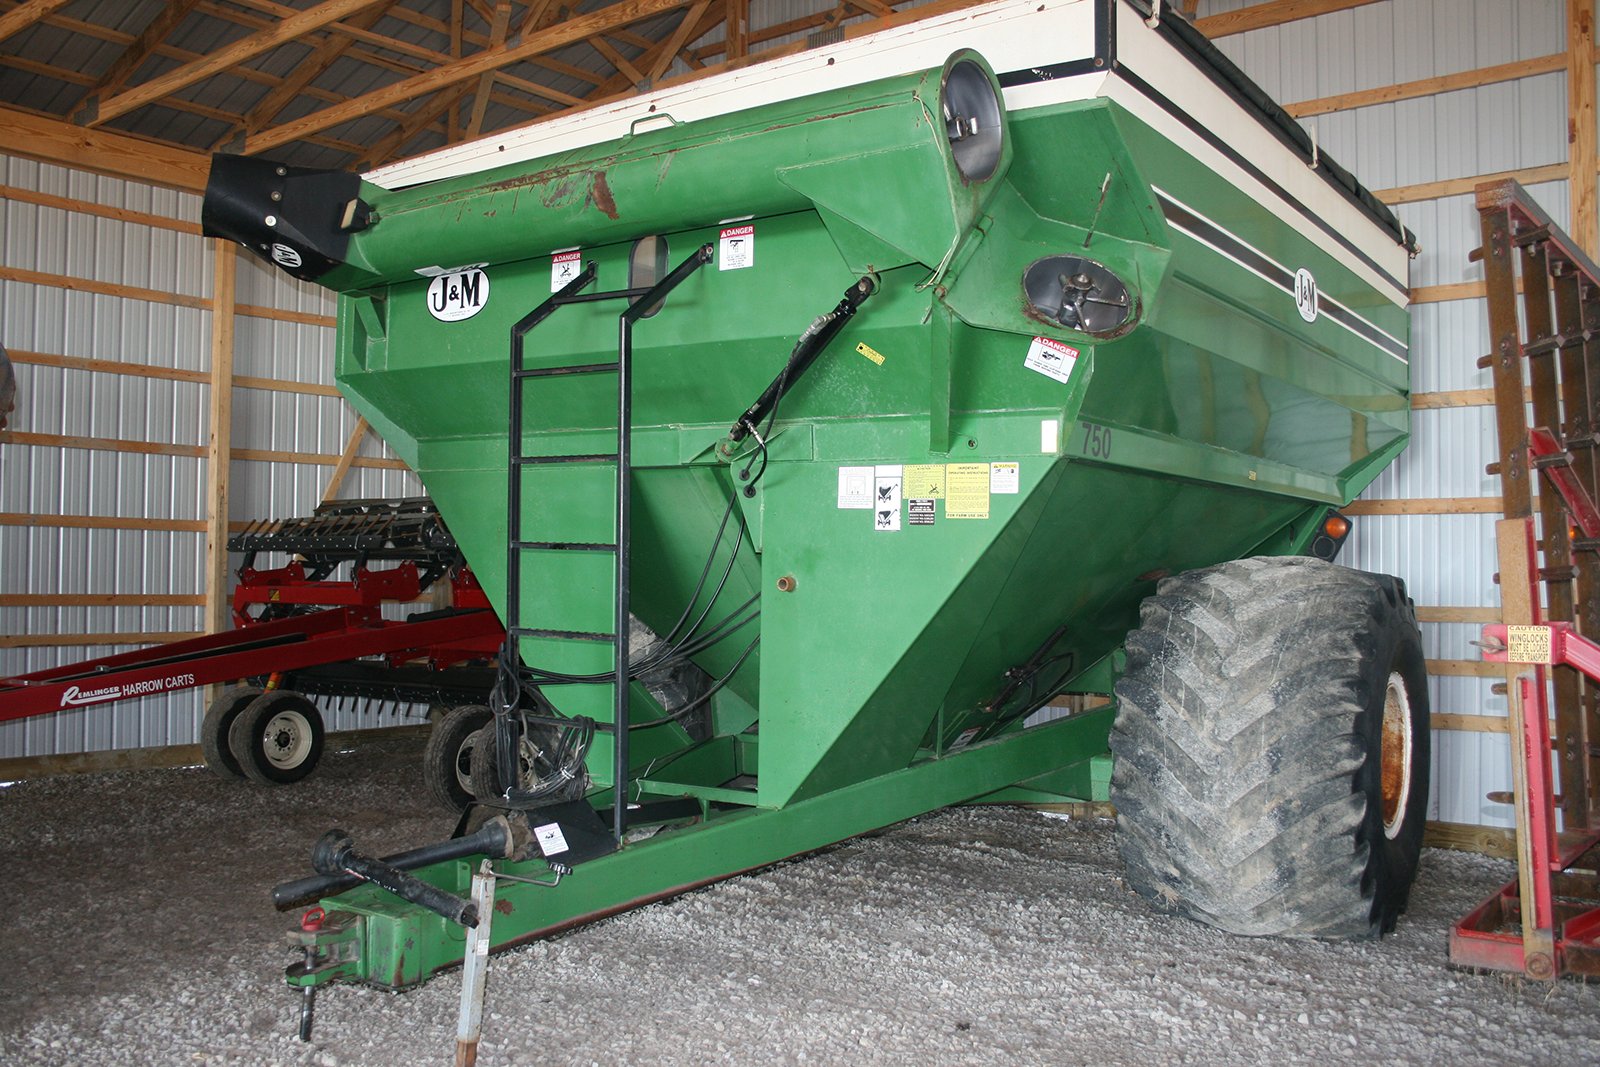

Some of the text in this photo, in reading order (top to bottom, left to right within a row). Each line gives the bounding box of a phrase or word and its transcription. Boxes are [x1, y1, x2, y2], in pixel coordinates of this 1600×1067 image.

[727, 226, 754, 237] DANGER
[558, 253, 581, 262] DANGER
[432, 271, 481, 312] J&M
[1296, 273, 1315, 314] J&M
[1042, 338, 1079, 358] DANGER
[1082, 422, 1112, 460] 750
[1510, 633, 1549, 643] WINGLOCKS
[1510, 643, 1522, 652] MUST
[1530, 643, 1549, 653] LOCKED
[1510, 652, 1549, 662] BEFORE TRANSPORT
[60, 673, 195, 707] REMLINGER HARROW CARTS
